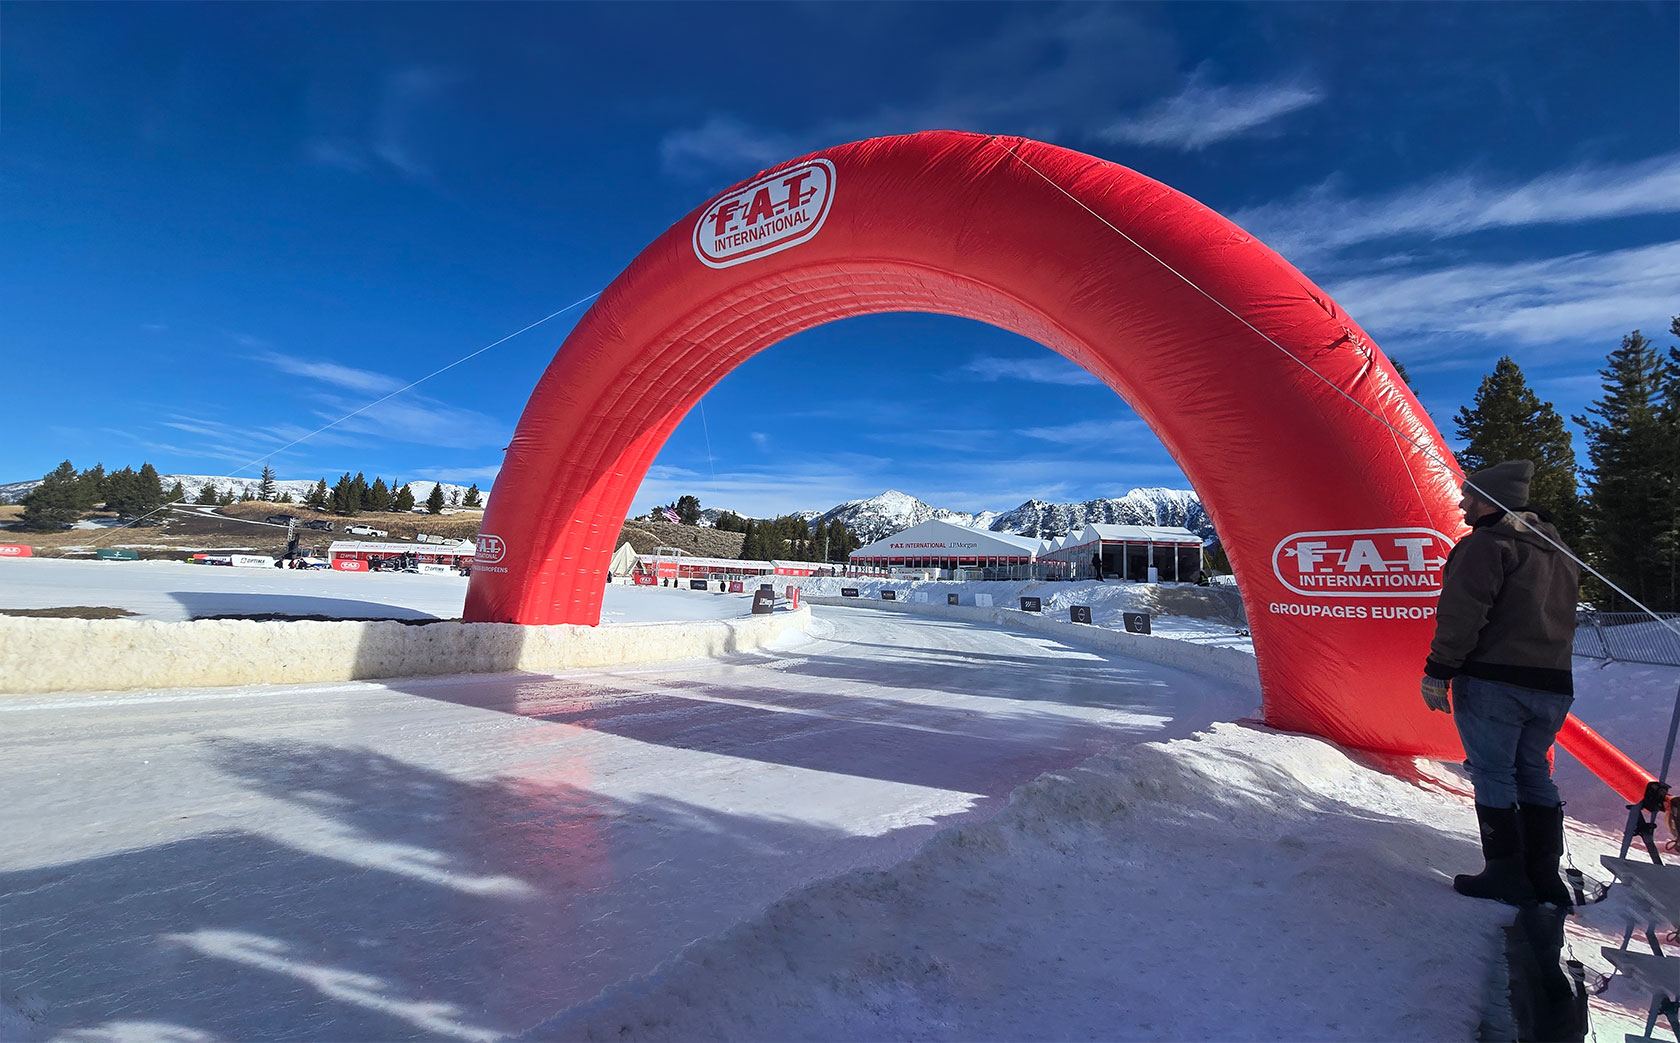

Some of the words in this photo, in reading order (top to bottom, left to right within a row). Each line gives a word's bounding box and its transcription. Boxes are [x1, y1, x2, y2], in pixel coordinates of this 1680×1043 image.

[714, 208, 810, 252] INTERNATIONAL
[1300, 574, 1441, 587] INTERNATIONAL
[1269, 602, 1368, 619] GROUPAGES
[1371, 606, 1438, 620] EUROP
